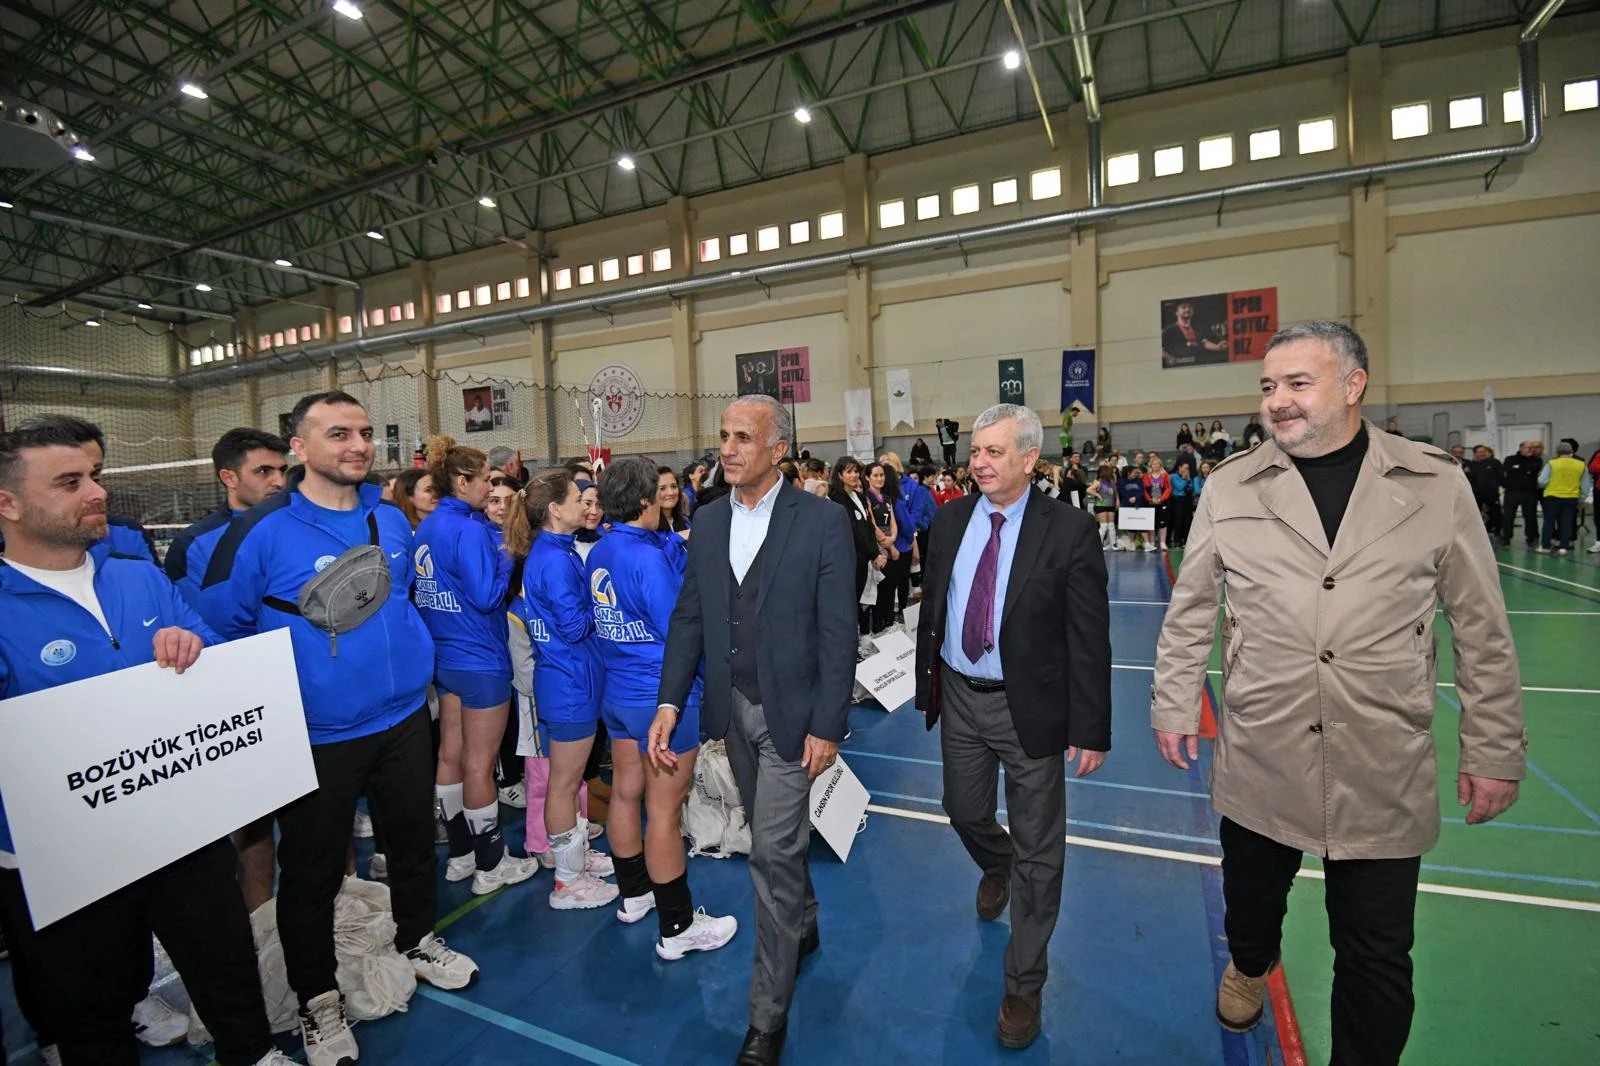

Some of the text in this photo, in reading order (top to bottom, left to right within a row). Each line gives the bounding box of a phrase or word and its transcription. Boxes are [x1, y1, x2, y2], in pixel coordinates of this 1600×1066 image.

[883, 513, 889, 525] 7
[67, 705, 264, 791] BOZÜYÜK TİCARET
[82, 728, 263, 809] VE SANAYİ ODASI
[824, 783, 834, 800] SPOR
